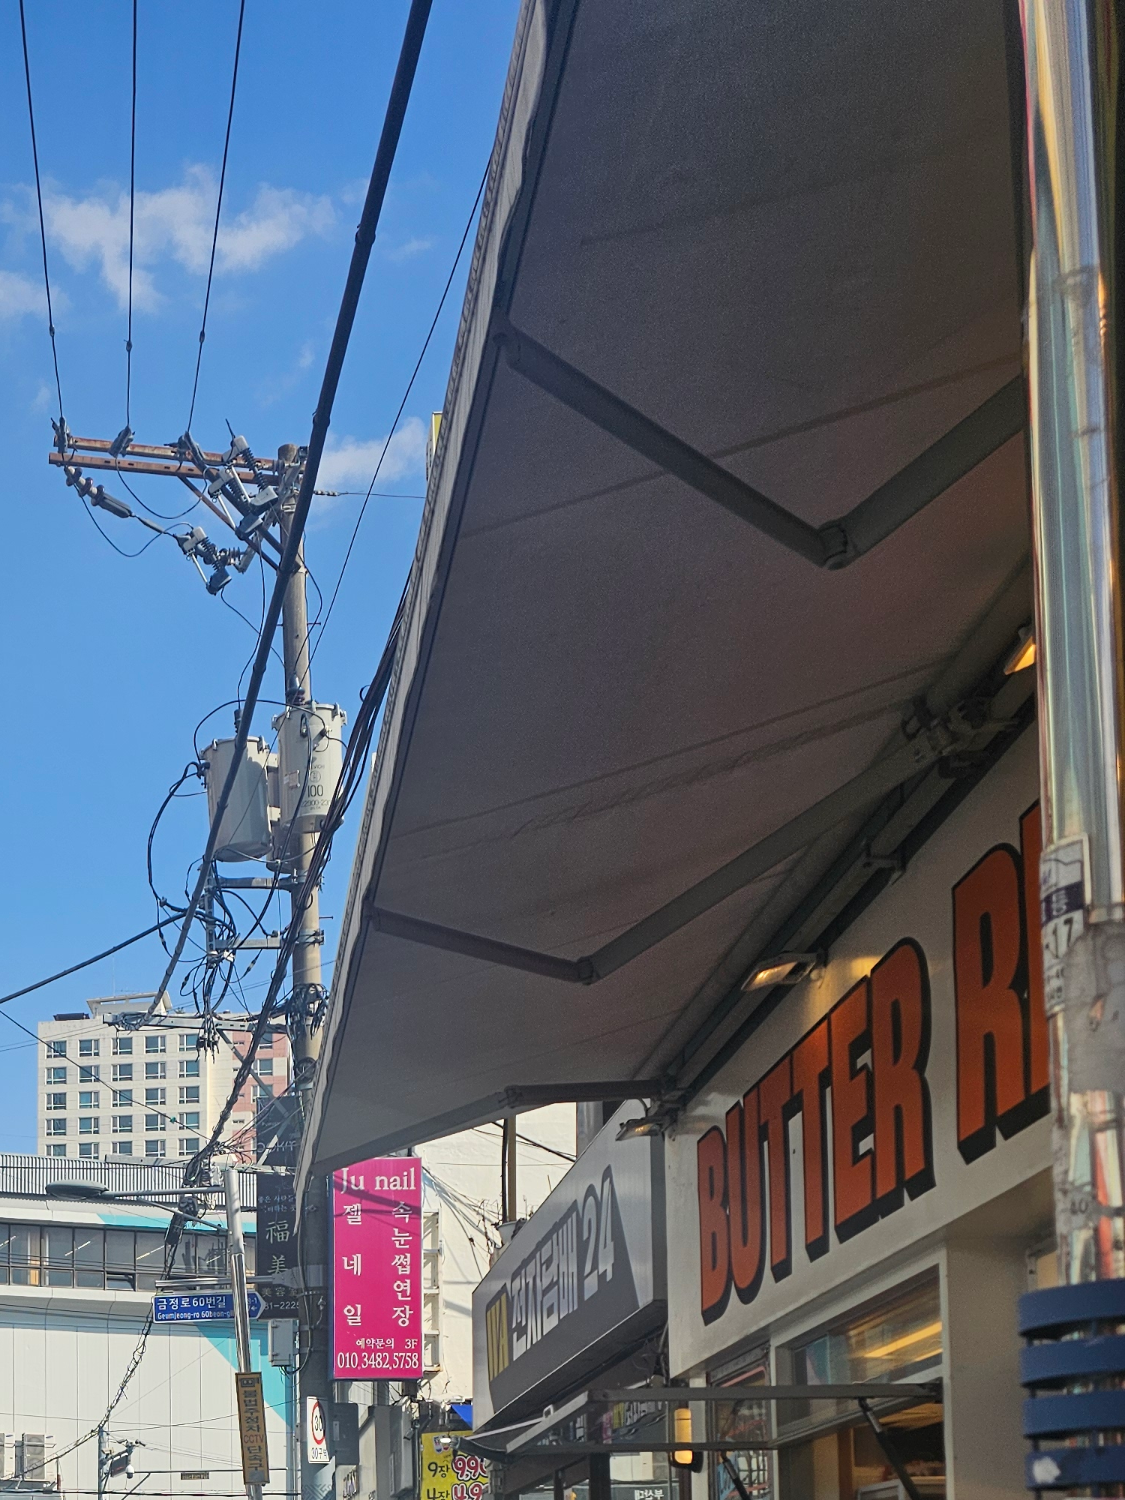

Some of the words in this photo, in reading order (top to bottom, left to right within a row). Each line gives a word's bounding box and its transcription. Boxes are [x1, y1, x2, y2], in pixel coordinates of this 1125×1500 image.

[697, 936, 937, 1326] BUTTER
[340, 1167, 364, 1194] Ju
[375, 1167, 416, 1190] nail
[391, 1201, 413, 1327] 속눈썹연장
[511, 1210, 578, 1362] 전자담배
[583, 1176, 615, 1302] 24
[355, 1338, 394, 1349] 예약문의
[404, 1338, 418, 1349] 3F
[243, 1433, 265, 1445] CCTV
[247, 1445, 264, 1472] 단속구
